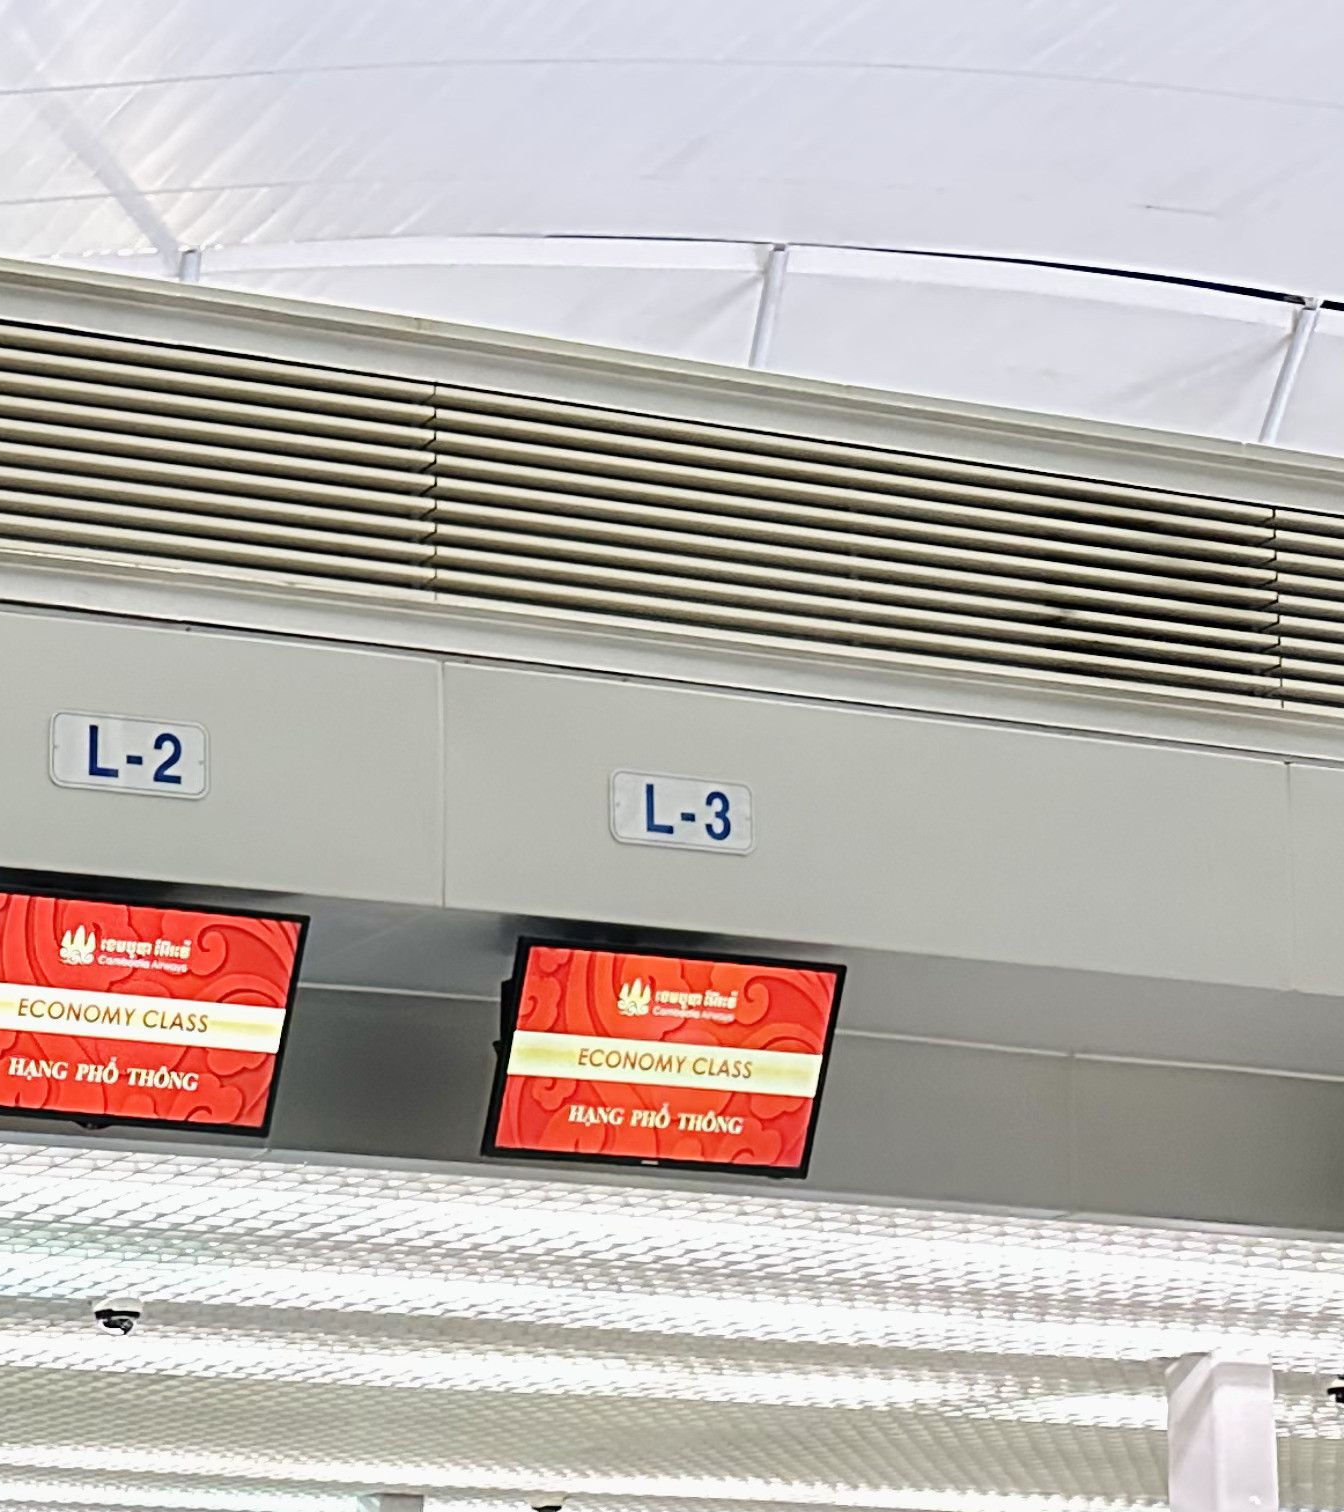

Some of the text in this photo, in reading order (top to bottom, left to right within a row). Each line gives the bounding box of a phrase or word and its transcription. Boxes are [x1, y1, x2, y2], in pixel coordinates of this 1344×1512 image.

[88, 724, 182, 785] L-2
[645, 783, 732, 841] L-3
[17, 998, 209, 1033] ECONOMY CLASS
[7, 1056, 200, 1091] HẠNG PHỔ THÔNG
[577, 1047, 753, 1079] ECONOMY CLASS
[567, 1102, 744, 1135] HẠNG PHỔ THÔNG
